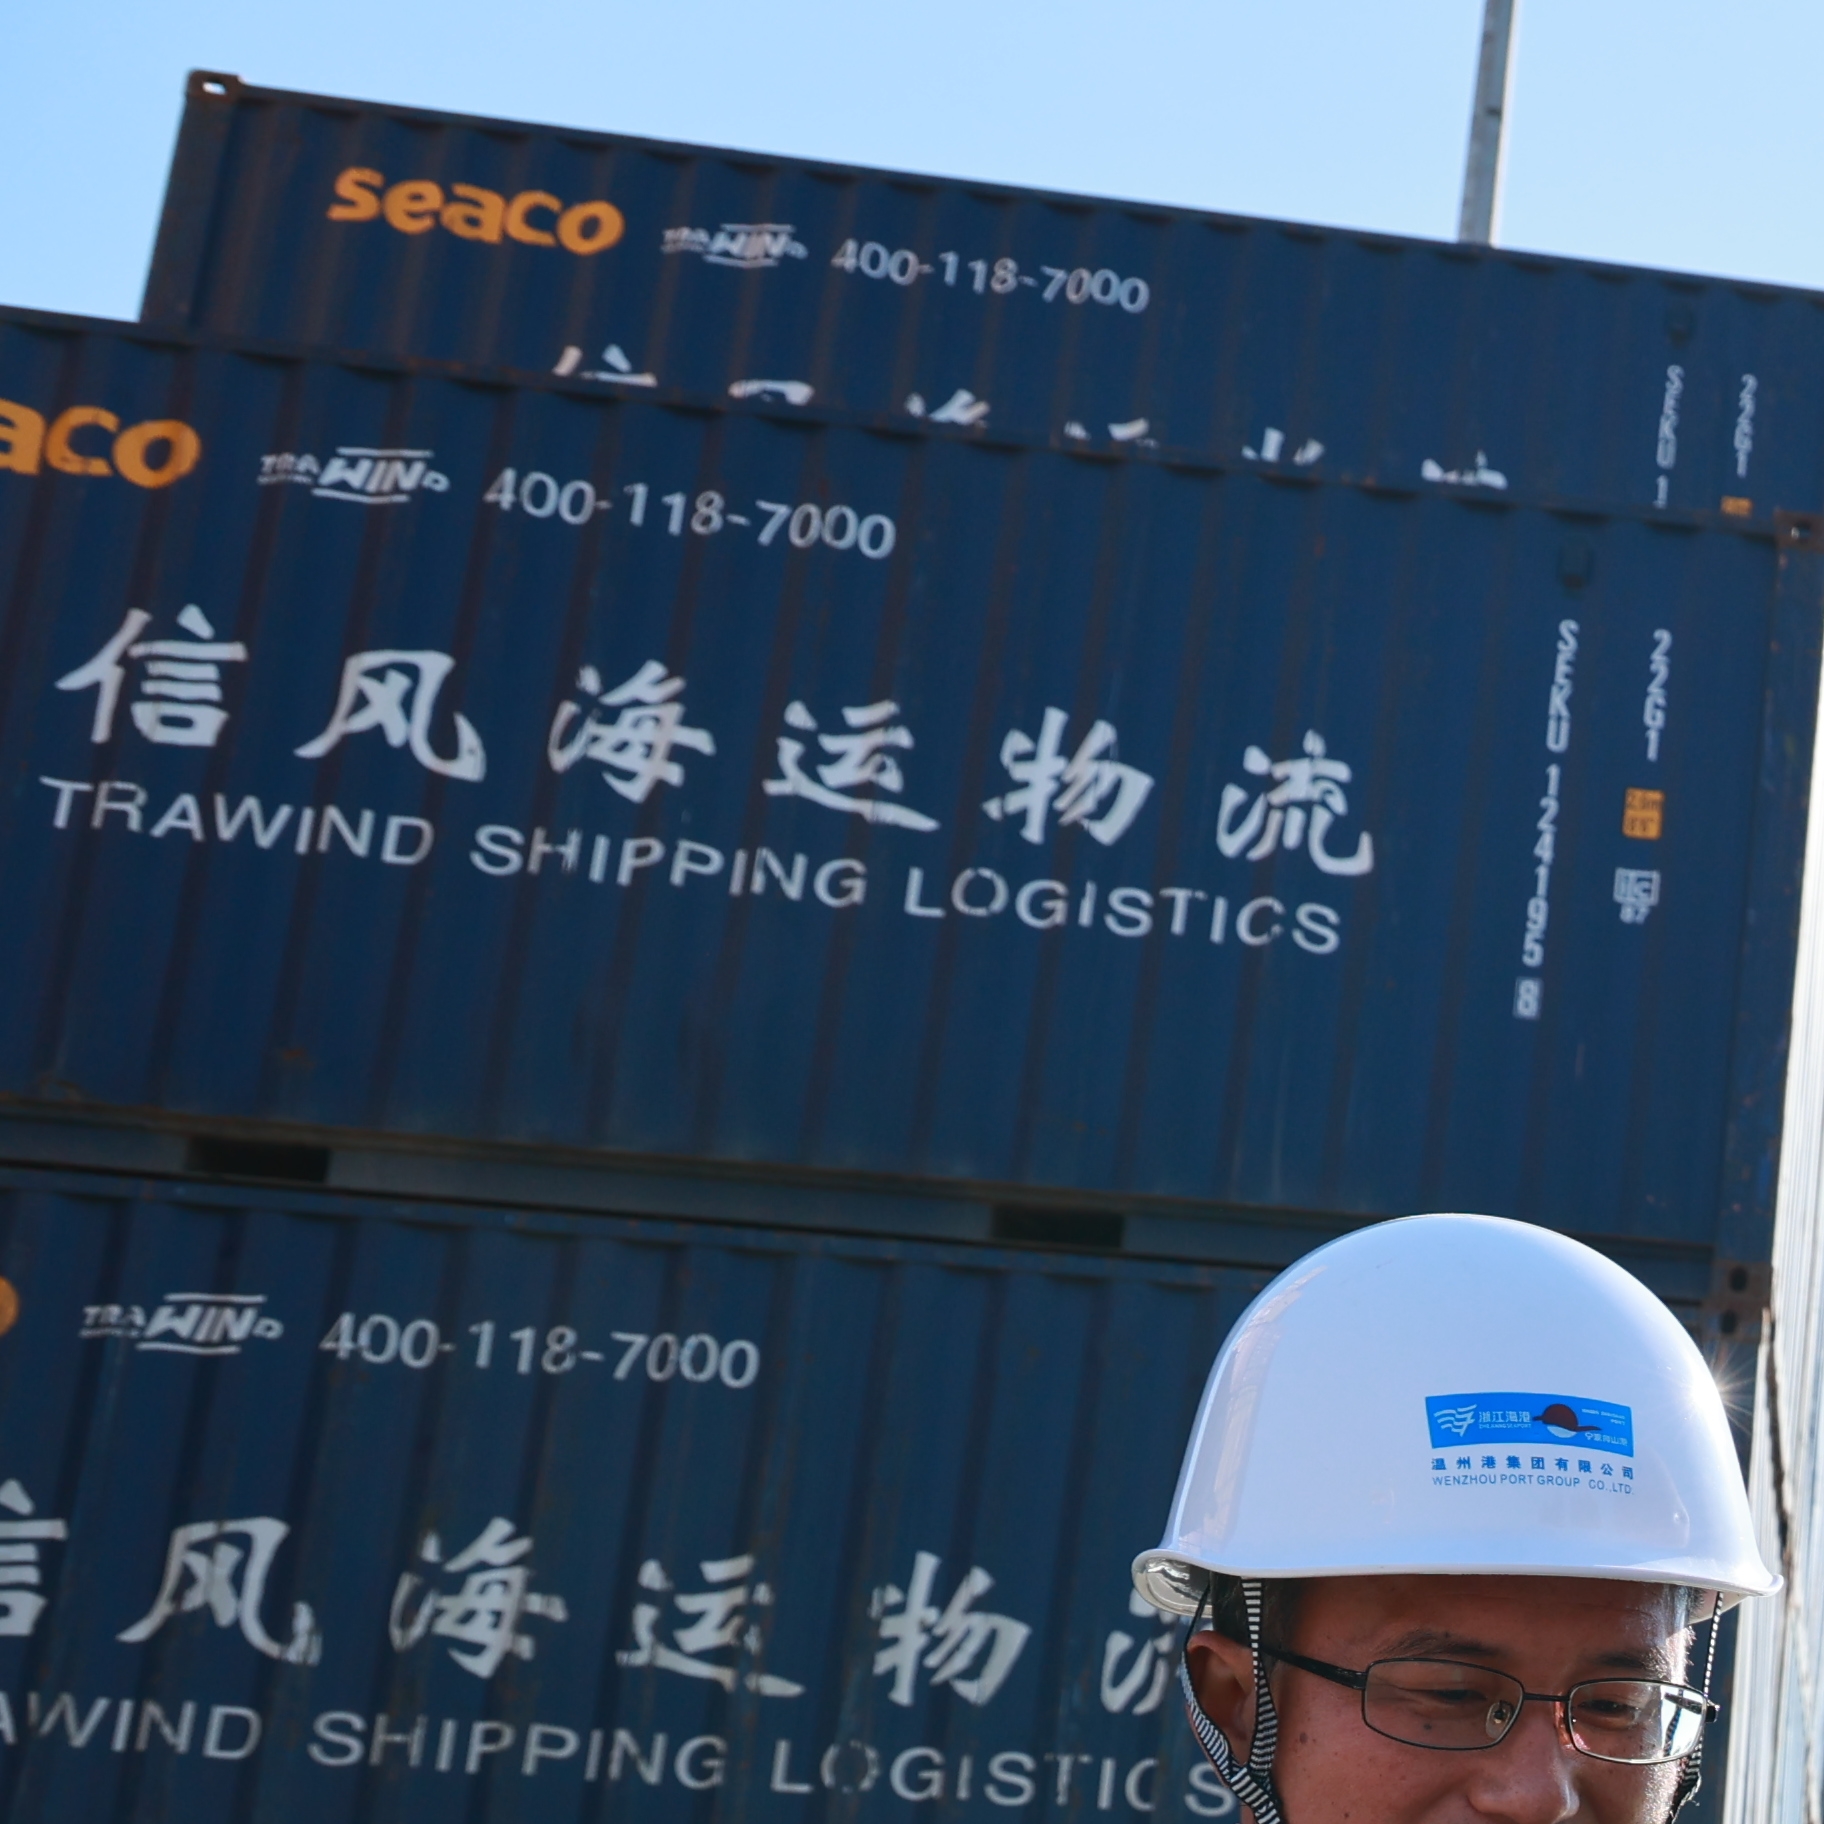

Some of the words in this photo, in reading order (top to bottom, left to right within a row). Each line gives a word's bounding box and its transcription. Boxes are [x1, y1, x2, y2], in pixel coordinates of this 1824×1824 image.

[328, 166, 624, 256] seaco
[830, 238, 1150, 313] 400-118-7000
[1733, 374, 1757, 477] 22G1
[484, 466, 896, 559] 400-118-7000
[1546, 619, 1580, 753] SEKU
[1643, 629, 1672, 762] 22G1
[56, 603, 1374, 876] 信风海运物流
[38, 776, 436, 867] TRAWIND
[469, 825, 868, 908] SHIPPING
[904, 866, 1342, 954] LOGISTICS
[320, 1312, 760, 1389] 400-118-7000
[1431, 1455, 1635, 1480] 温州港集团有限公司
[1432, 1474, 1497, 1486] WENZHOU
[1500, 1474, 1534, 1485] PORT
[1537, 1475, 1580, 1487] GROUP
[308, 1710, 727, 1790] SHIPPING
[770, 1738, 1237, 1817] LOGISTICS
